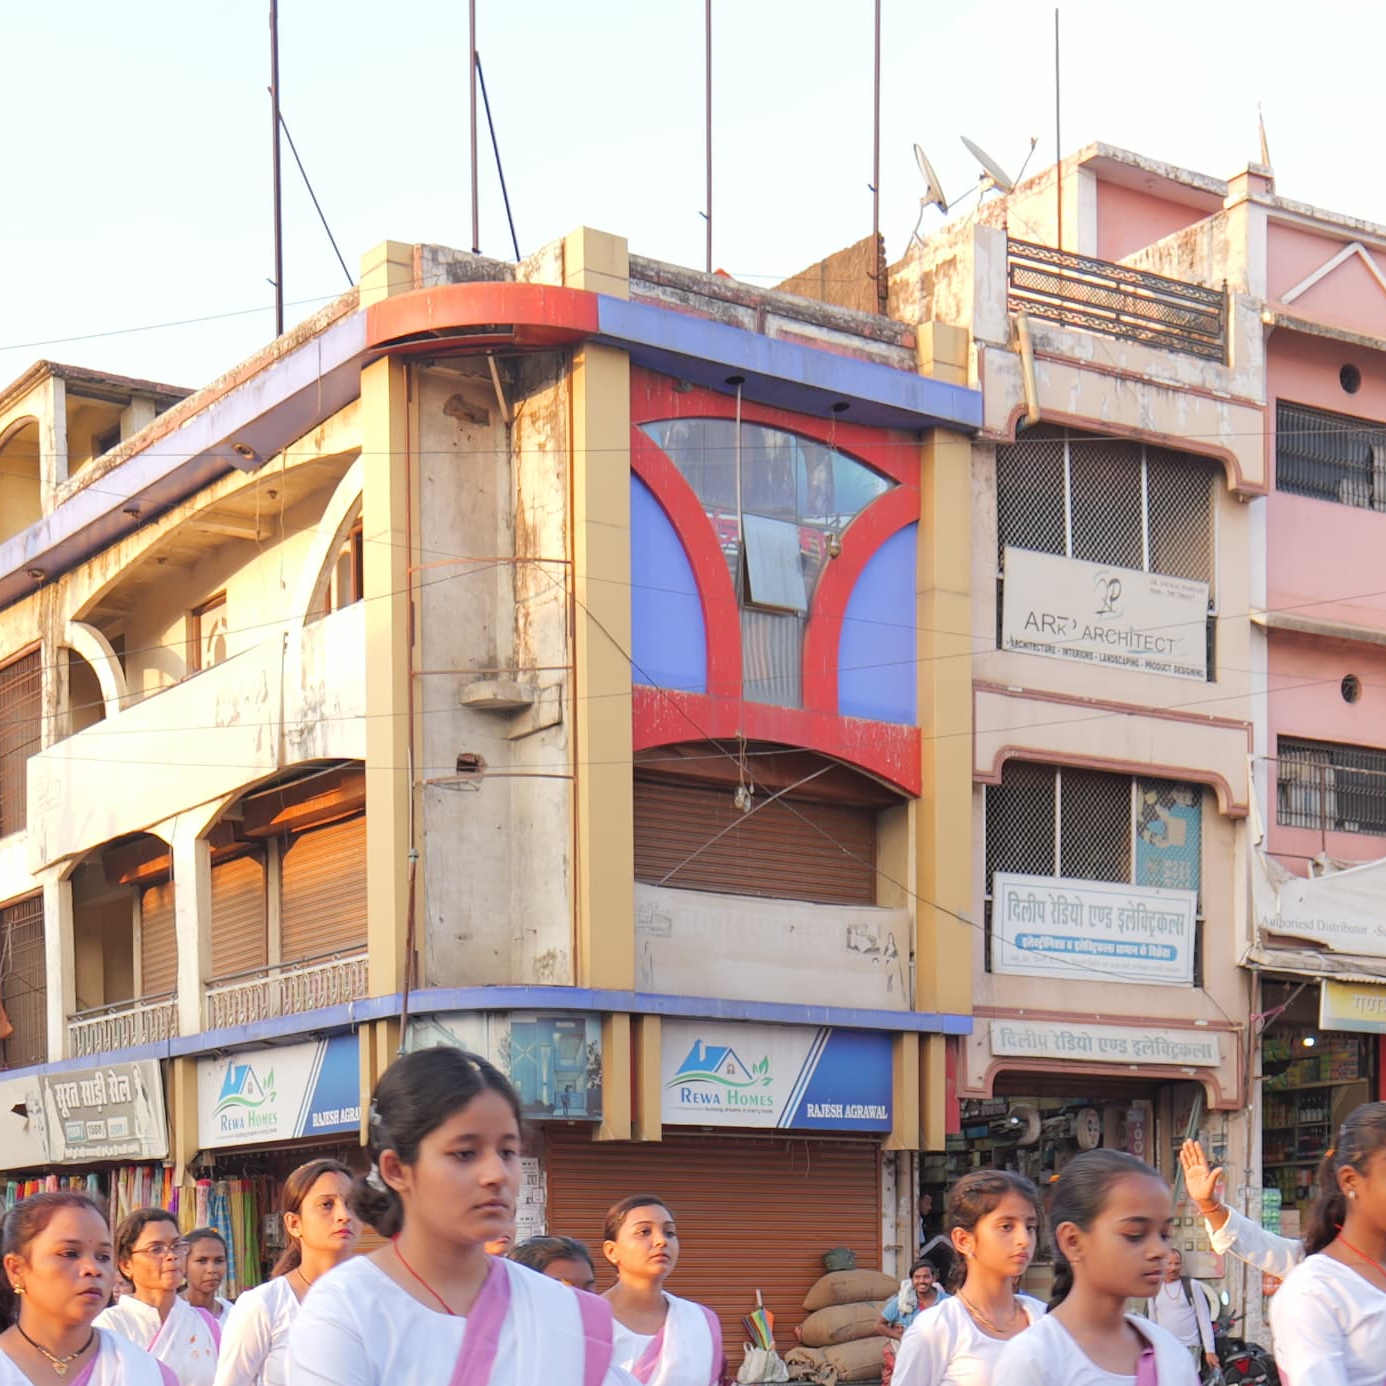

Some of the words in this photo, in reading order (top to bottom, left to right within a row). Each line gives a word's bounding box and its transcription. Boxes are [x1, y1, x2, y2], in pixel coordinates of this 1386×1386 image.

[1062, 647, 1093, 661] INTERIORS
[1099, 654, 1139, 669] LANDSCAPING
[1145, 661, 1172, 673] PRODUCT
[1173, 665, 1204, 679] DESIGNING
[1007, 891, 1047, 924] दिलीप
[1049, 893, 1085, 927] रेडियो
[1089, 904, 1114, 930] एण्ड
[1317, 919, 1368, 936] Distributor
[999, 1026, 1048, 1050] दिलीप
[1053, 1029, 1093, 1052] रेडियो
[1097, 1034, 1128, 1054] एण्ड
[108, 1070, 132, 1105] सेल
[681, 1087, 720, 1105] REWA
[727, 1089, 774, 1106] HOMES
[221, 1114, 245, 1132] REWA
[248, 1109, 278, 1128] HOMES
[313, 1112, 340, 1128] RAJESH
[806, 1104, 844, 1119] RAJESH
[844, 1105, 888, 1120] AGRAWAL
